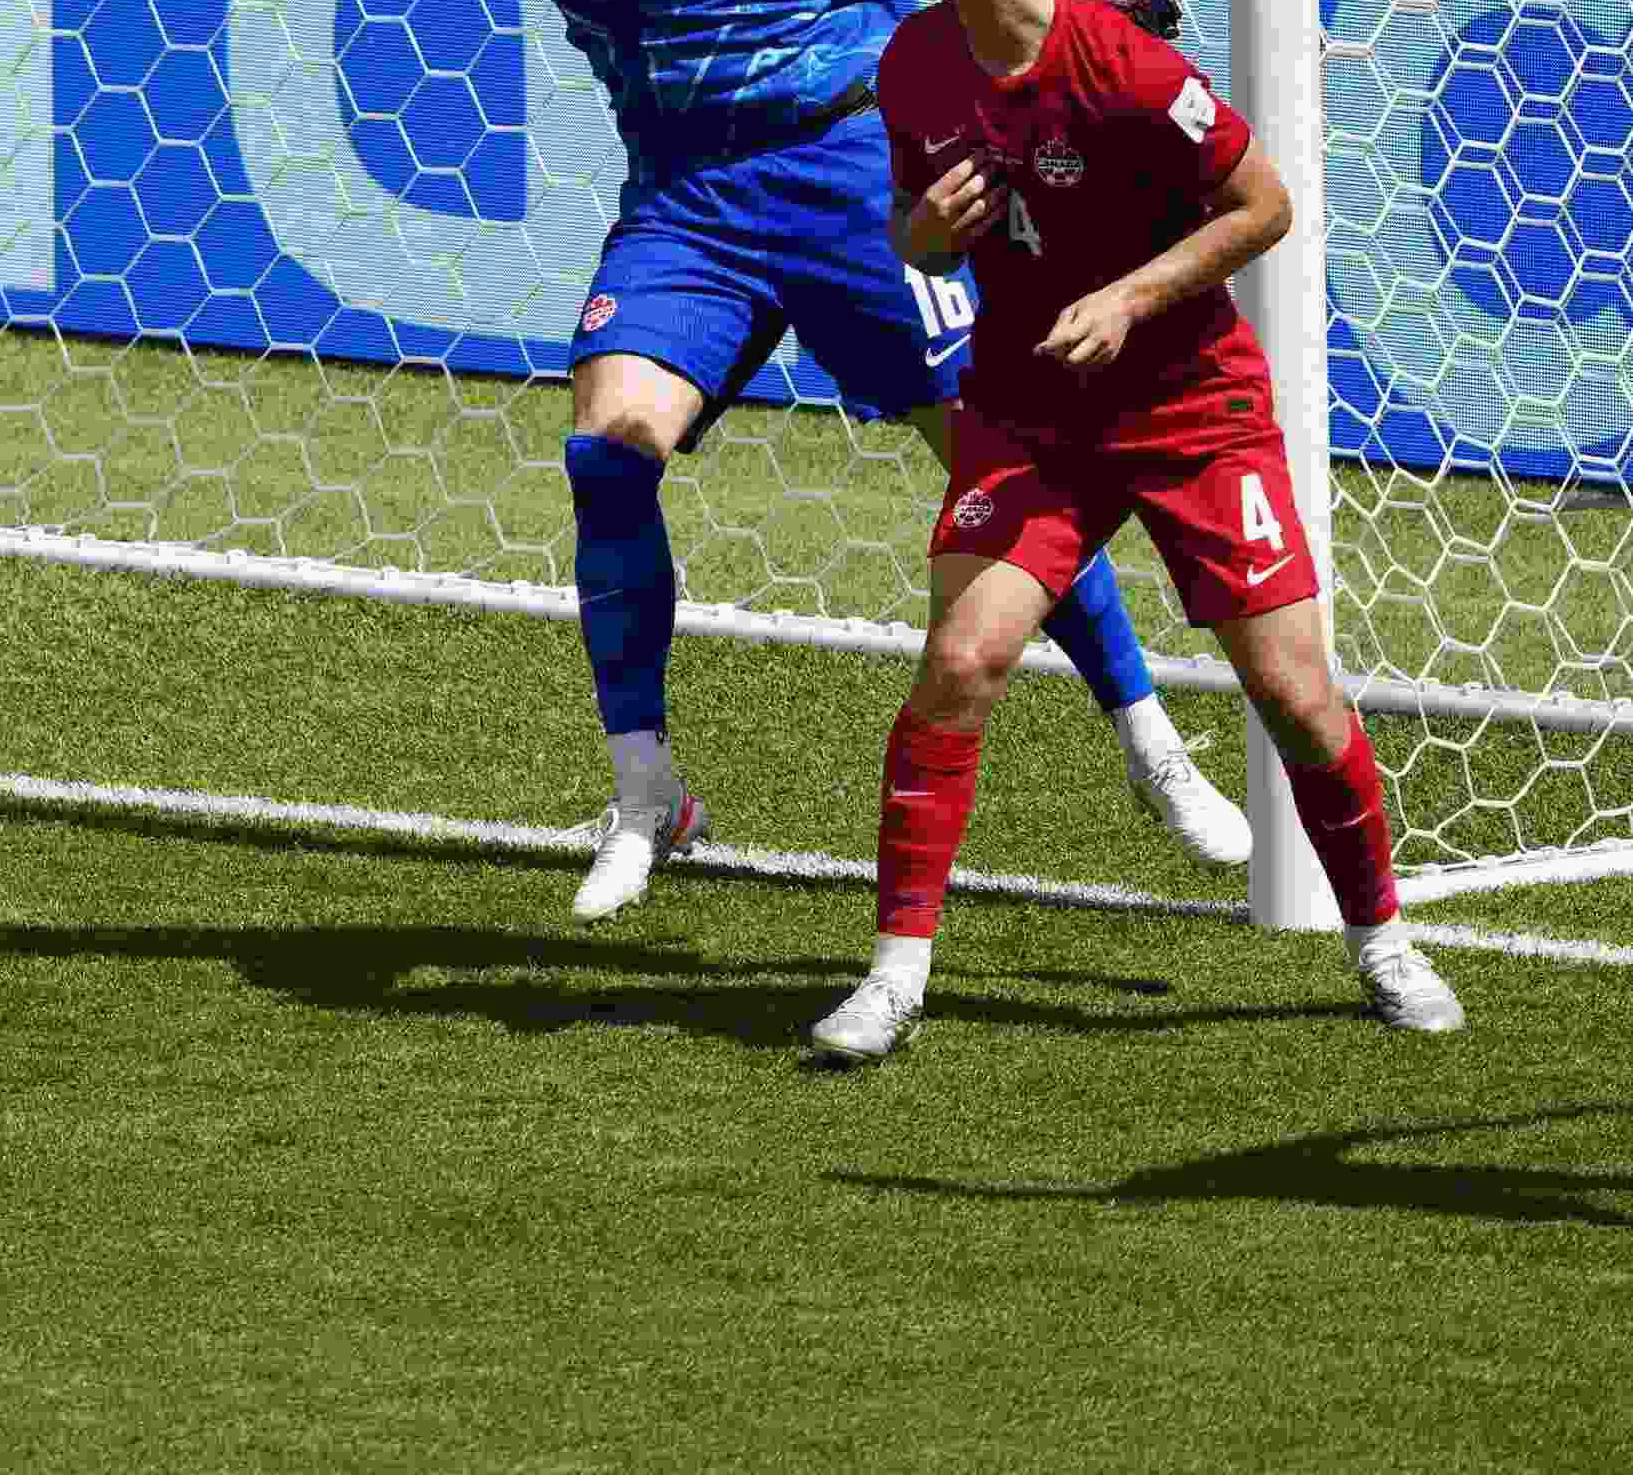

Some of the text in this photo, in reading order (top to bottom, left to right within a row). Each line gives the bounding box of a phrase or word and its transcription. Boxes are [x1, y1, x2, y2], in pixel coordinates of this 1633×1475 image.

[1007, 188, 1043, 257] 4
[904, 263, 977, 340] 16
[1239, 472, 1286, 553] 4
